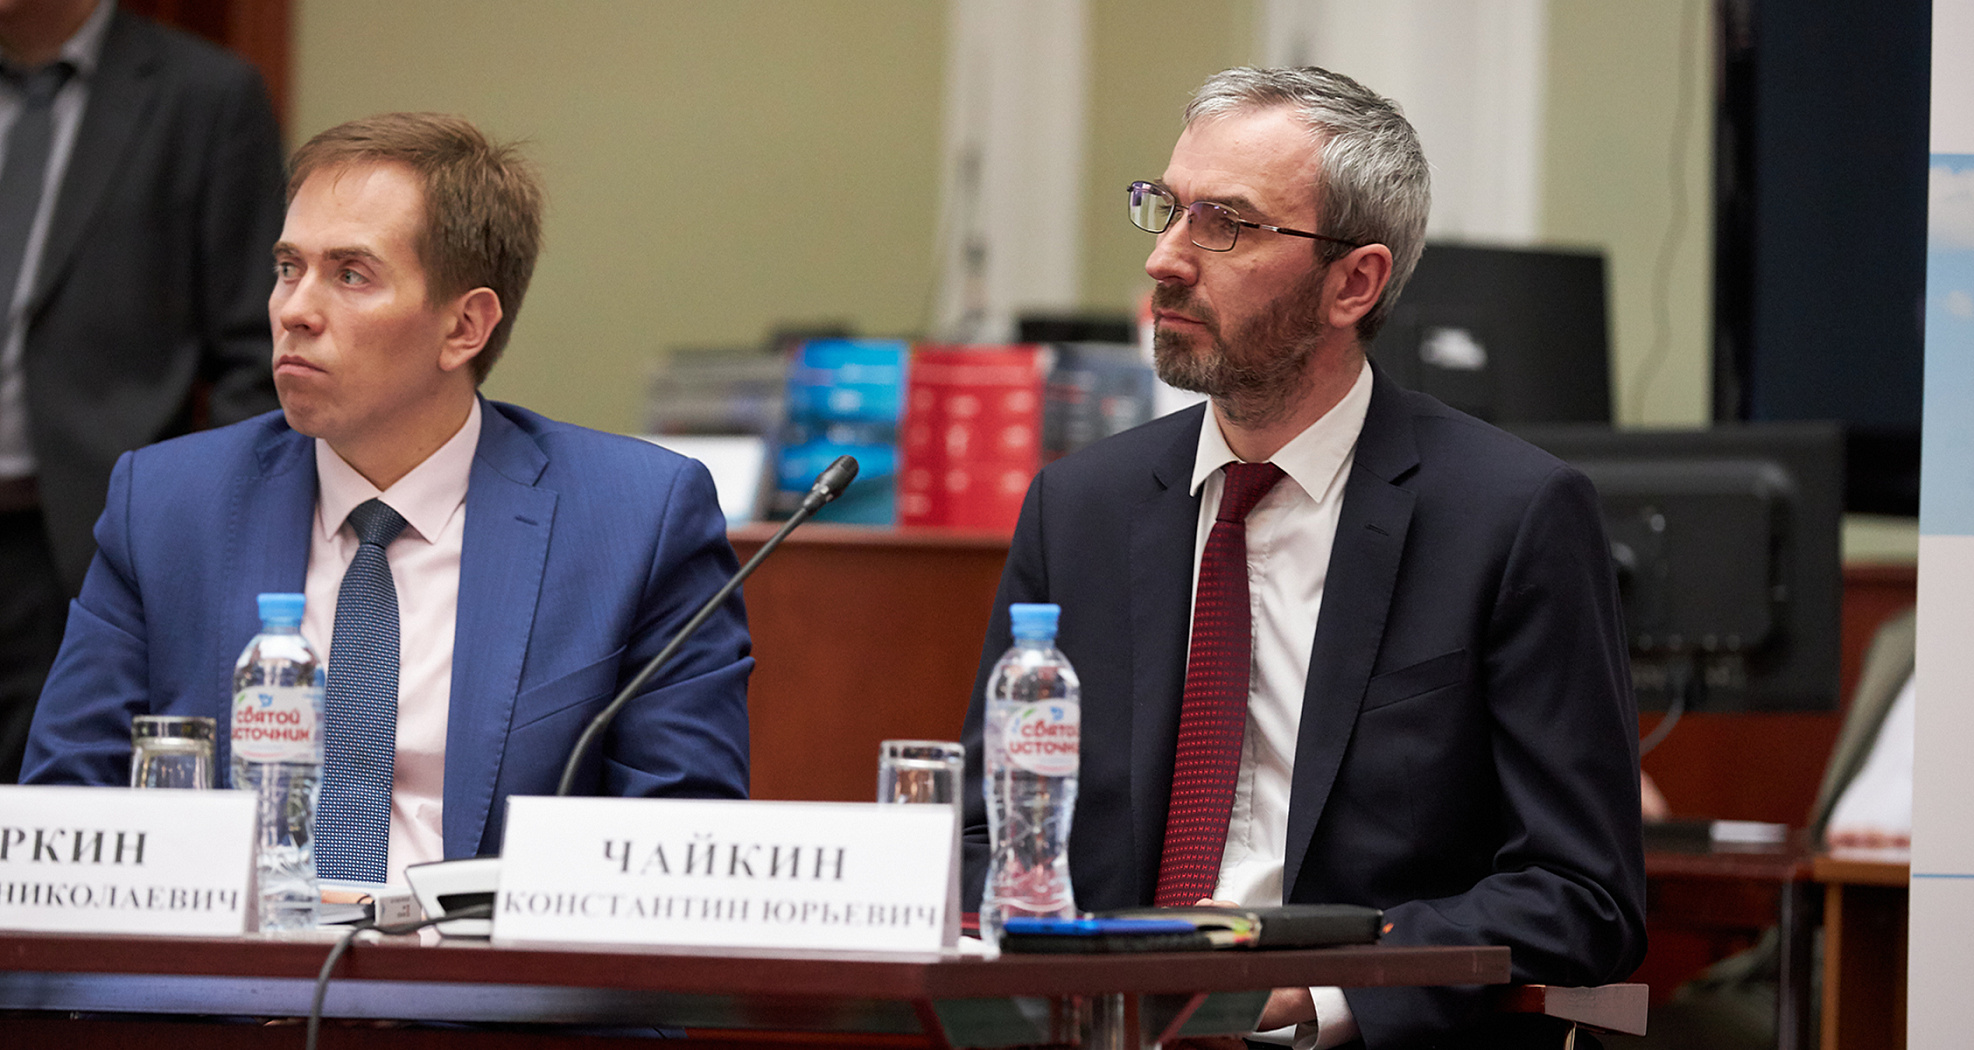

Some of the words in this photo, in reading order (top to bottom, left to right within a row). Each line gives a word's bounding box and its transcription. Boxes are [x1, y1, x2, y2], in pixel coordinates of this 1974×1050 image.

[1021, 719, 1079, 738] СВЯТО
[1009, 741, 1079, 755] ИСТОЧН
[0, 826, 147, 865] РКИН
[603, 832, 845, 880] ЧАЙКИН
[0, 881, 238, 912] НИКОЛАЕВИЧ
[503, 890, 749, 921] КОНСТАНТИН
[762, 900, 937, 928] ЮРЬЕВИЧ
